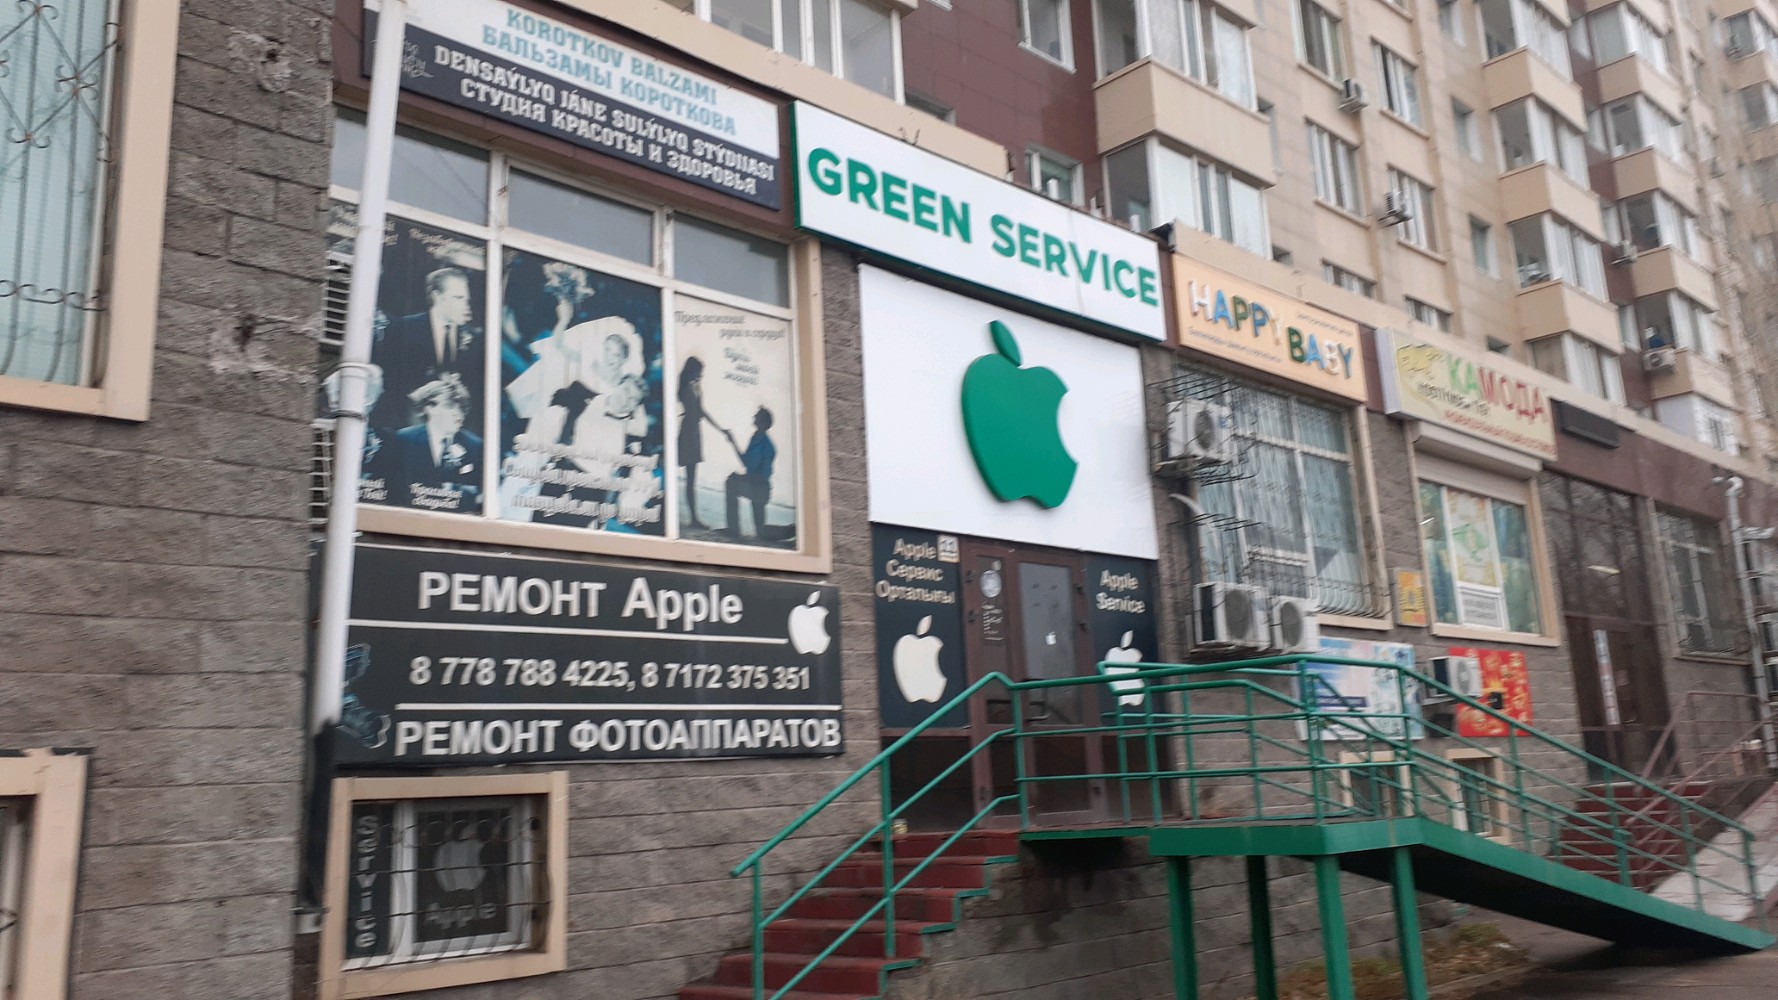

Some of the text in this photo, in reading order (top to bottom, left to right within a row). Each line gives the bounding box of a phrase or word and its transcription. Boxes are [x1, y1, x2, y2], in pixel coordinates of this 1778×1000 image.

[482, 24, 613, 90] БАЛЬЗАМЫ
[620, 77, 737, 136] КОРОТКОВА
[506, 8, 717, 105] KOROTKOV BALZAMI
[460, 78, 757, 195] СТУДИЯ КРАСОТЫ И ЗДОРОВЬЯ
[808, 147, 1160, 307] GREEN SERVICE
[1188, 279, 1283, 346] HAPPY
[1287, 325, 1353, 380] BABY
[886, 559, 944, 582] Сервис
[893, 538, 937, 561] Apple
[417, 571, 743, 631] РЕМОНТ Apple
[1096, 592, 1146, 614] Service
[1101, 569, 1139, 591] Apple
[409, 656, 810, 692] 8 778 788 4225, 8 7172 375 351
[395, 717, 842, 757] РЕМОНТ ФОТОАППАРАТОВ
